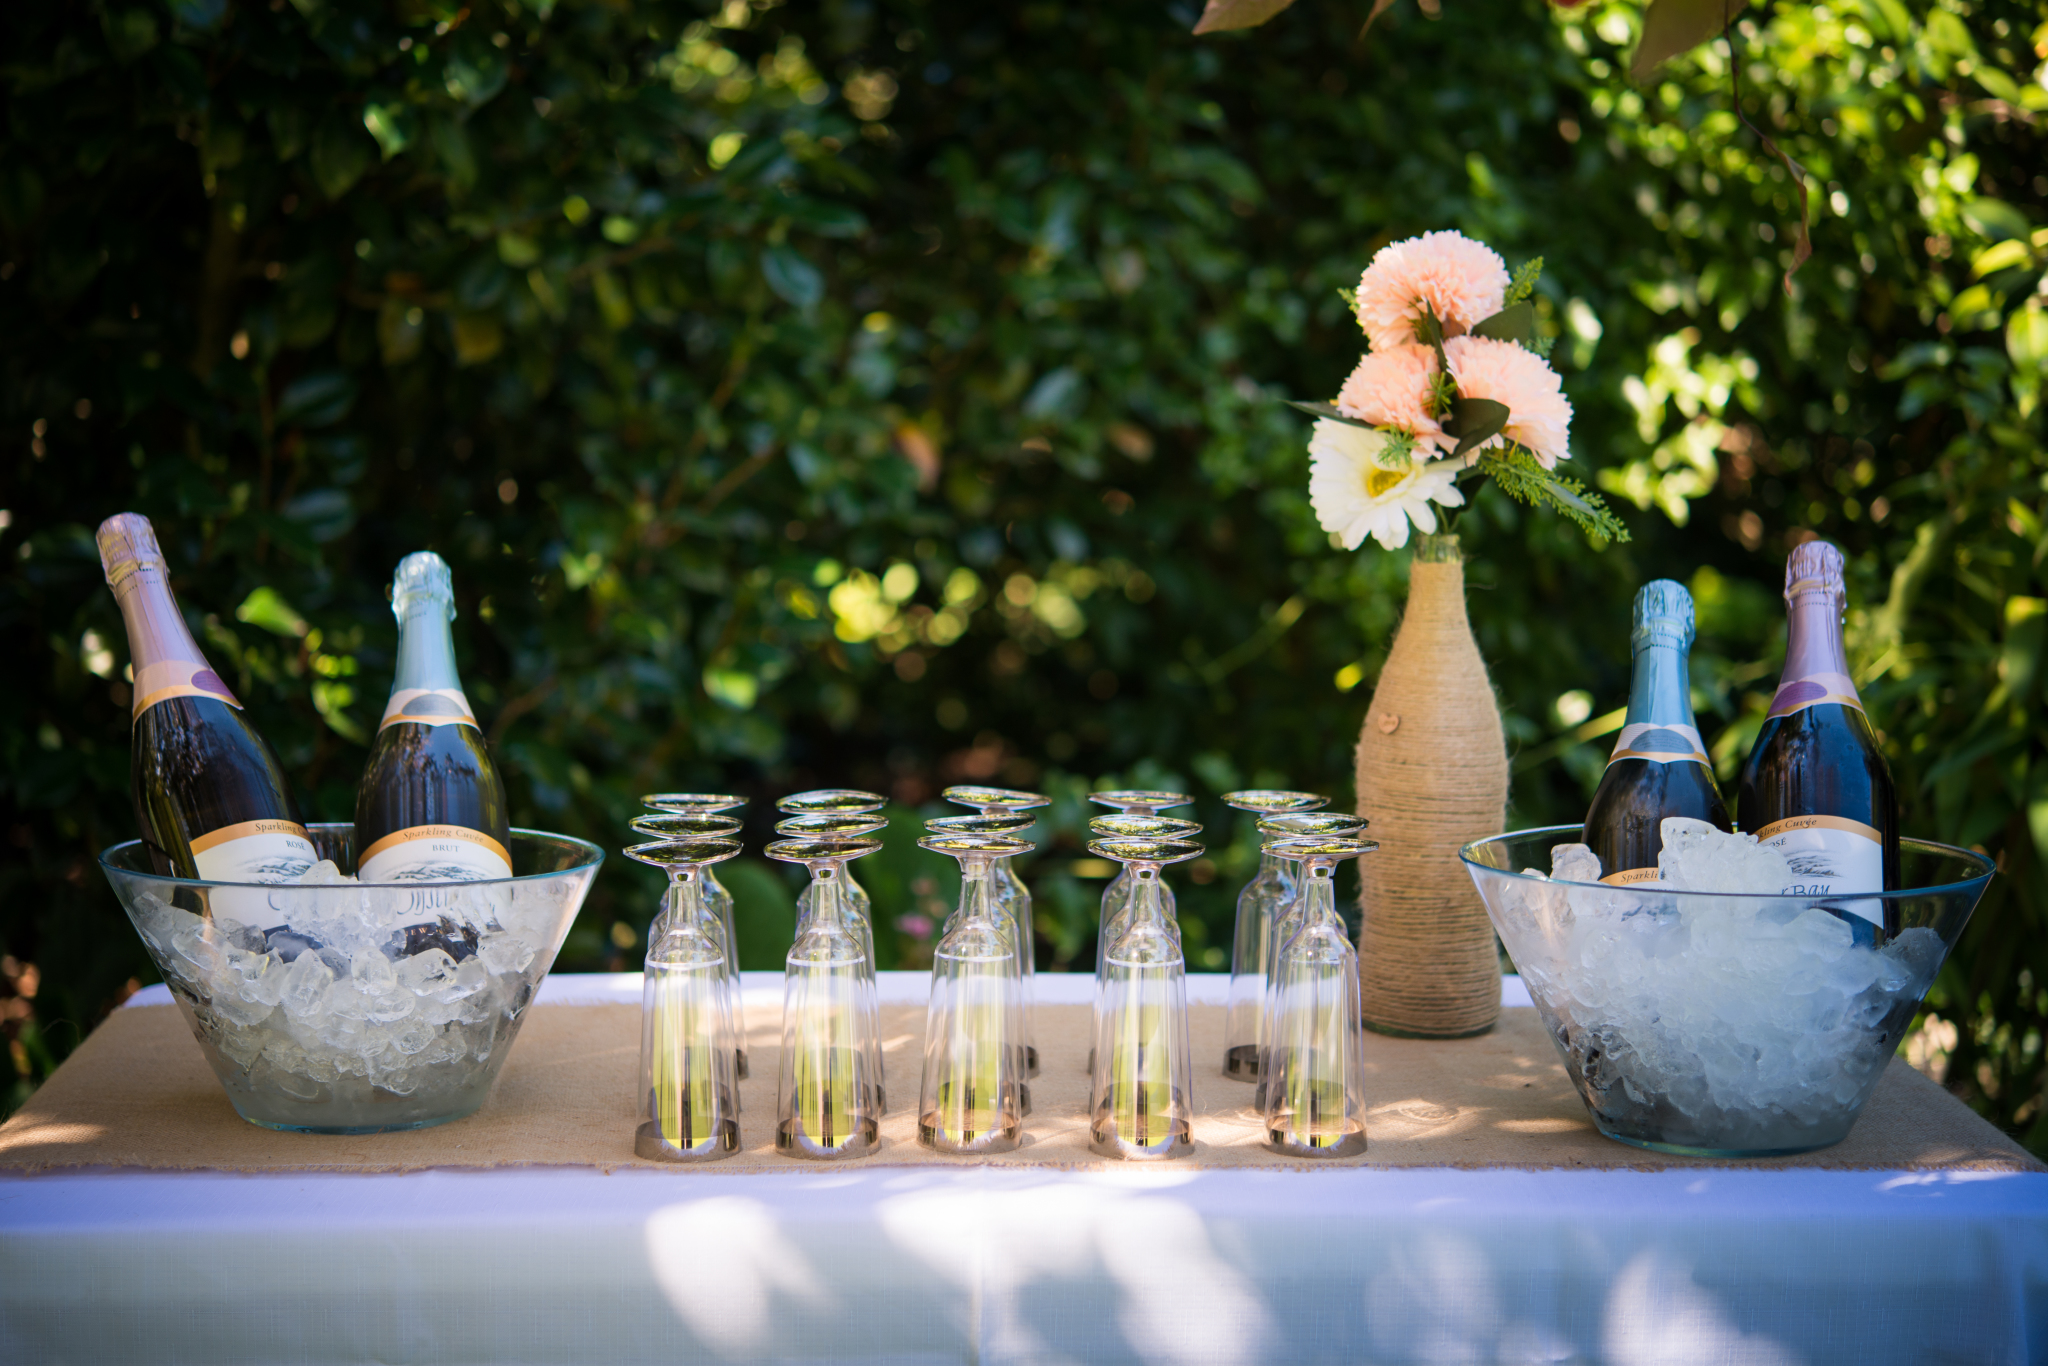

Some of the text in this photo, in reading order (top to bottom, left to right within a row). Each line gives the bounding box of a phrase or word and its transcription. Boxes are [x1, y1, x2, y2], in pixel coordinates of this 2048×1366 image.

[255, 822, 298, 834] Sparkling
[1758, 817, 1818, 838] kling Cuvée
[403, 828, 452, 841] Sparkling
[432, 844, 460, 853] BRUT
[1621, 870, 1658, 882] Sparkli
